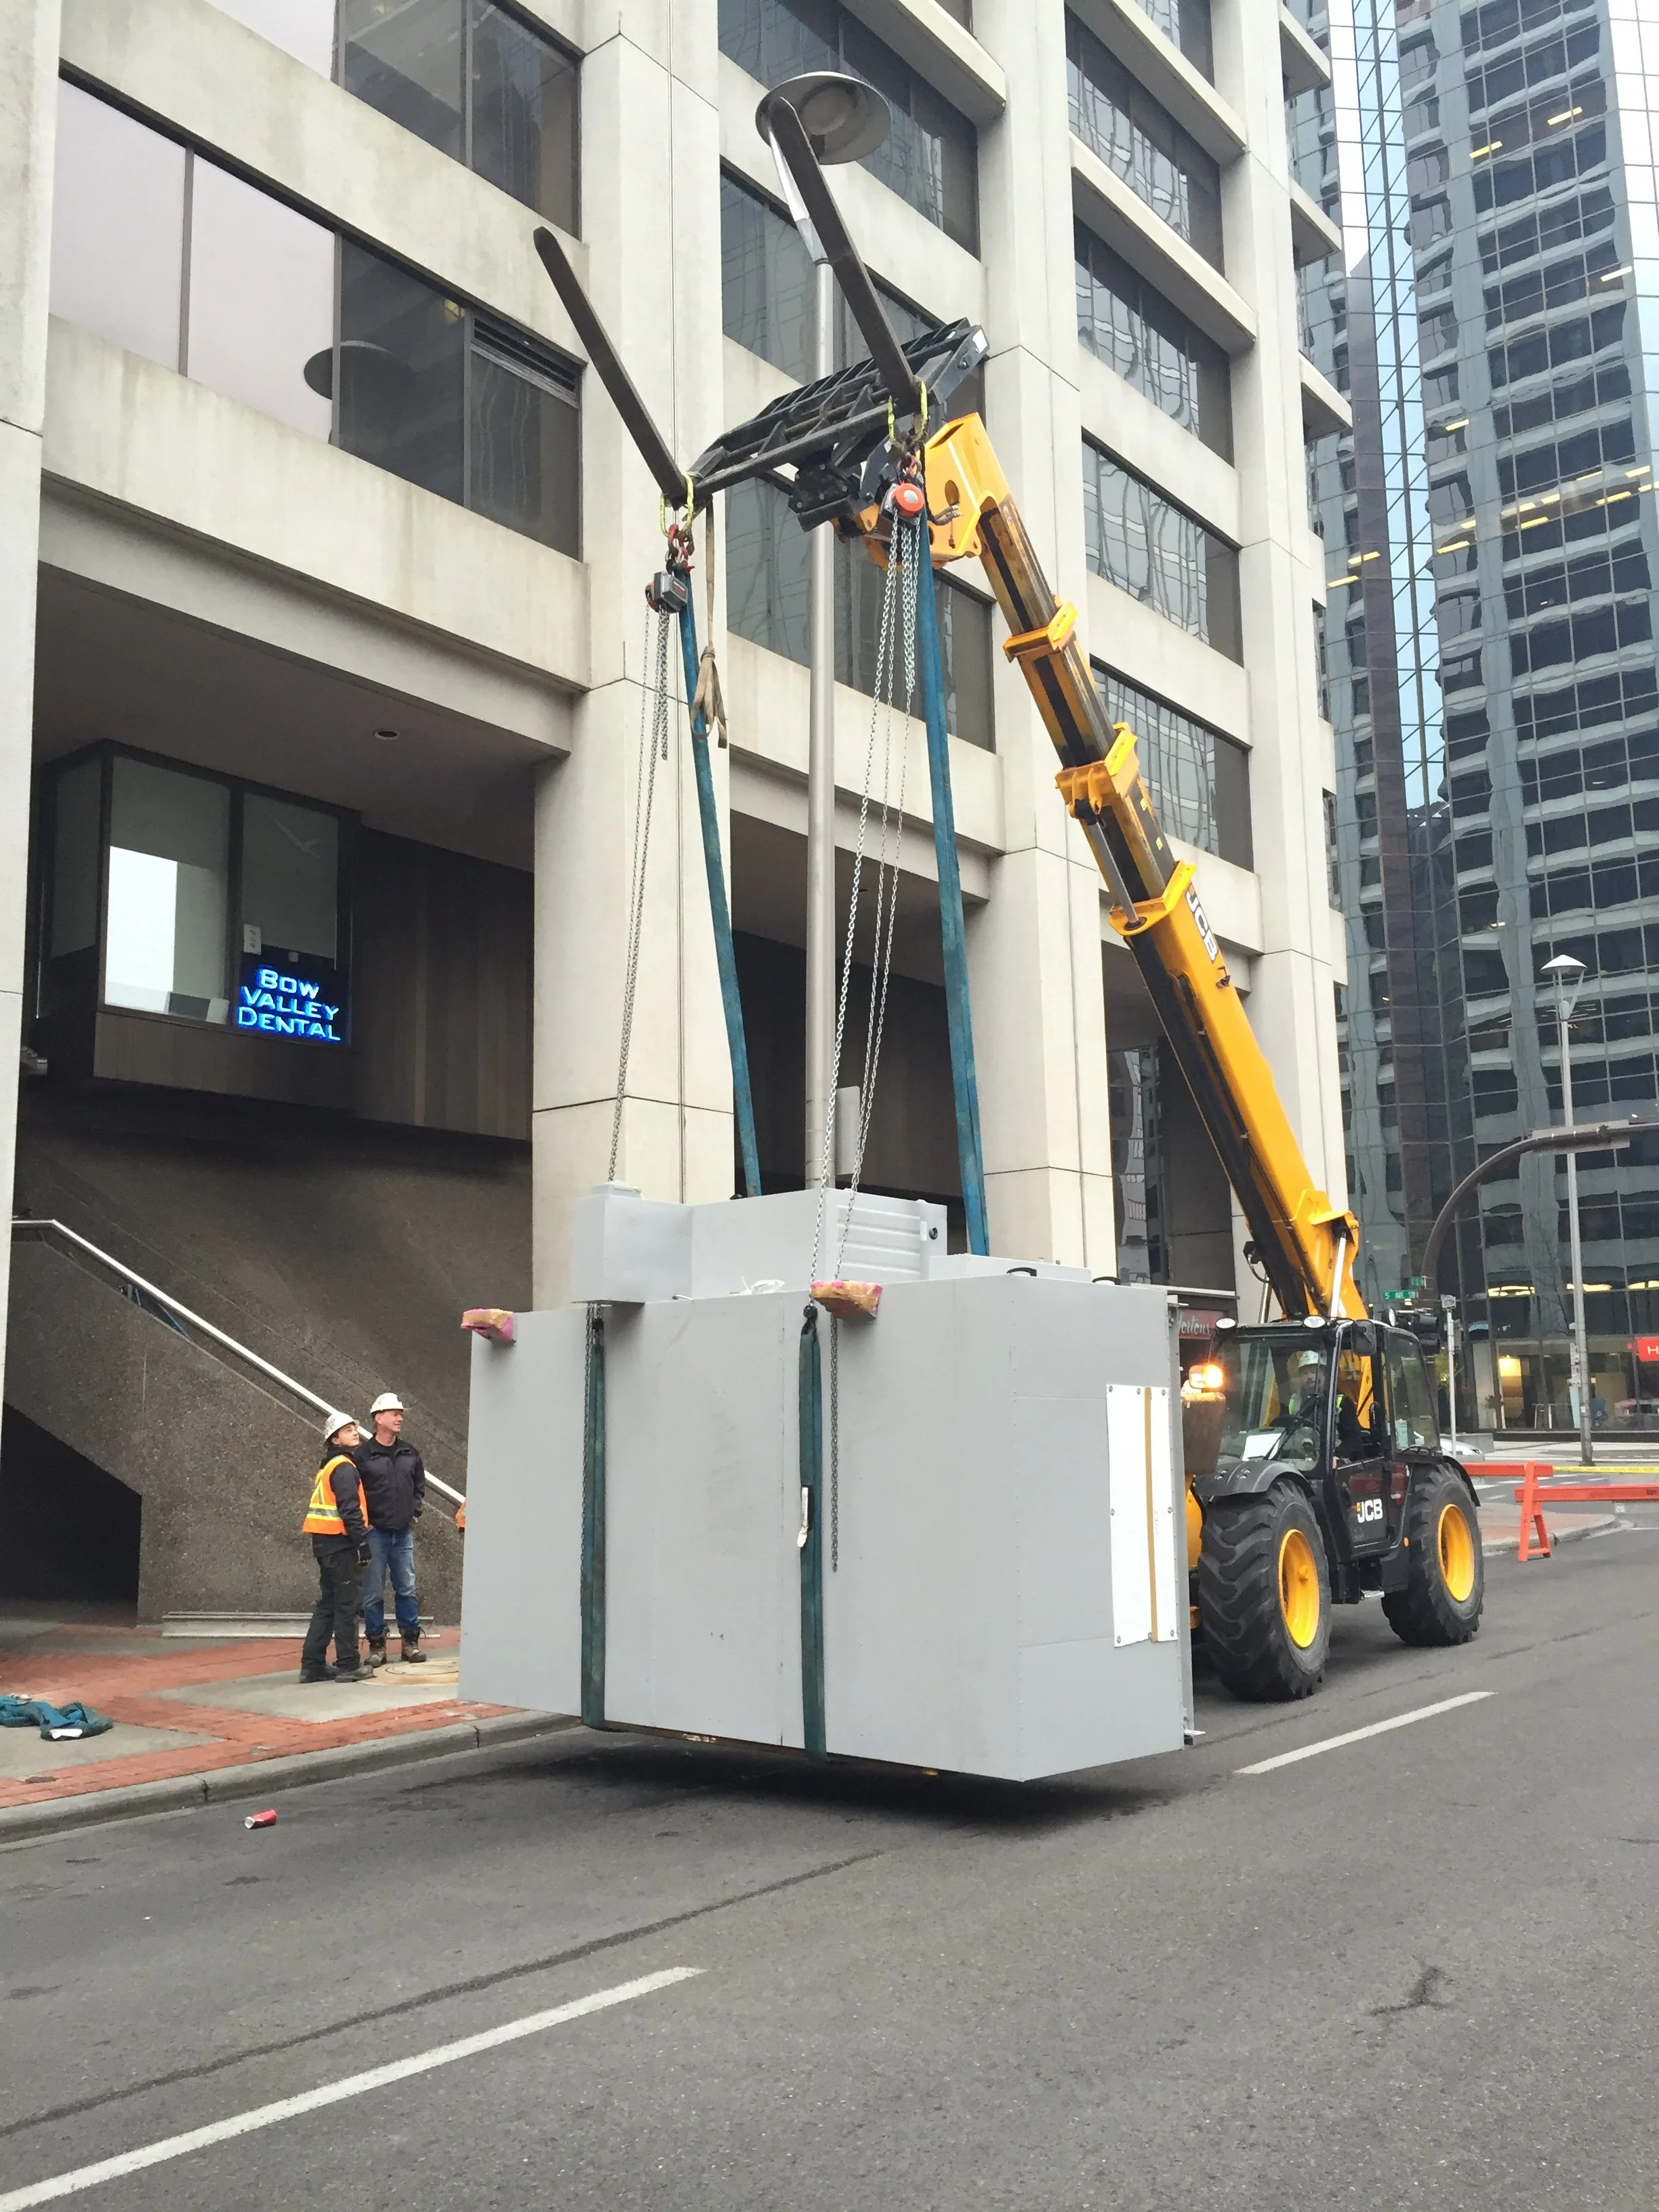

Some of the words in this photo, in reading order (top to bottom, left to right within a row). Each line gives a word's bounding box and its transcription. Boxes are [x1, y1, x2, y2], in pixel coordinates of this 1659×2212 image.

[1186, 885, 1218, 961] JCB
[258, 968, 320, 1000] BOW
[241, 985, 340, 1021] VALLEY
[237, 1006, 342, 1041] DENTAL
[1356, 1498, 1383, 1523] JCB
